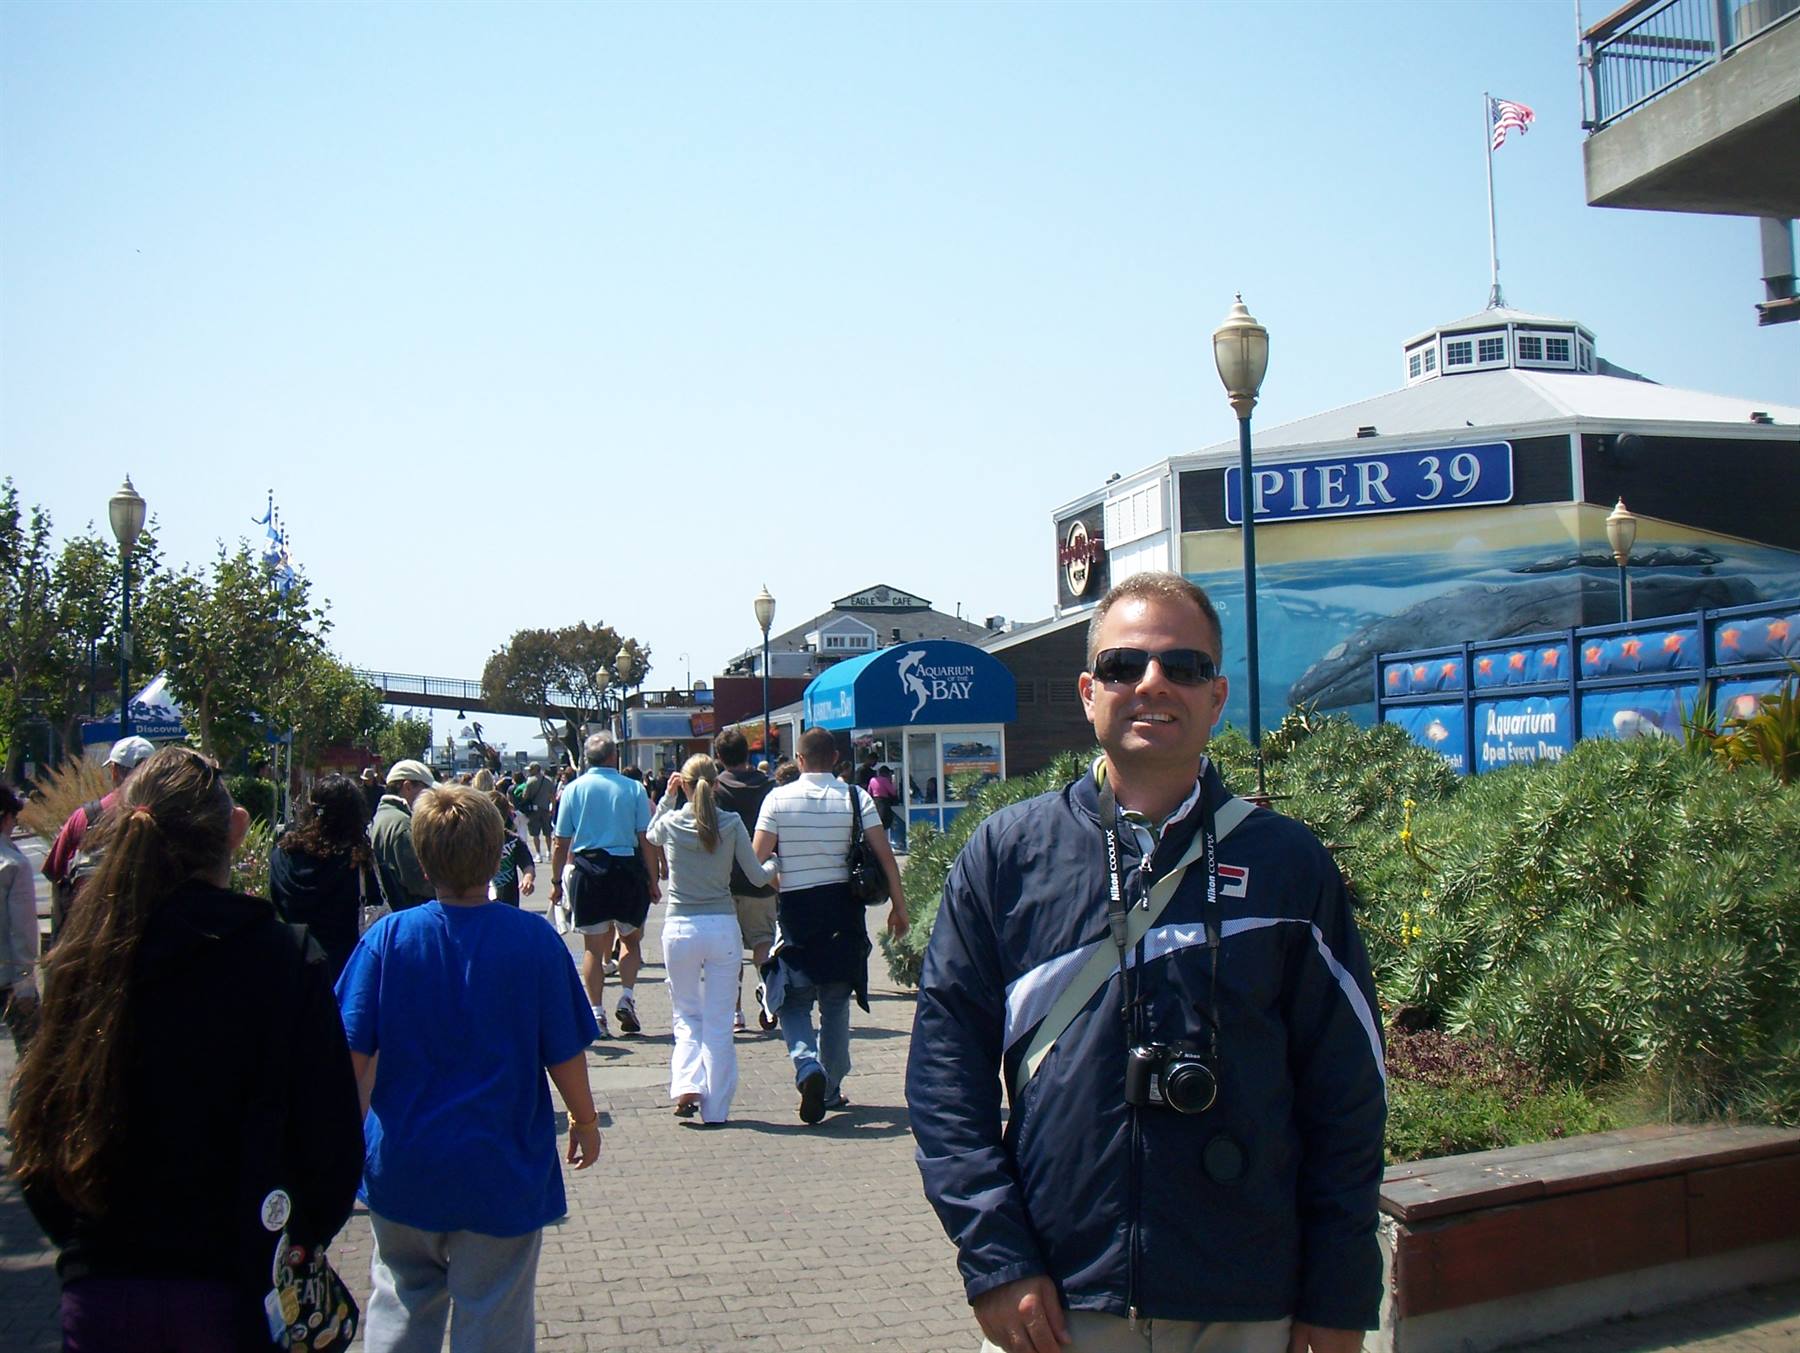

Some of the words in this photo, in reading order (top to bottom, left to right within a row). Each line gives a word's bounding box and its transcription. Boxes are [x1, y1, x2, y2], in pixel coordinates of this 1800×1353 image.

[1253, 461, 1396, 514] PIER
[1416, 453, 1481, 500] 39
[851, 597, 876, 606] EAGLE
[892, 597, 912, 606] CAFE
[915, 664, 974, 680] AQUARIUM
[932, 680, 973, 700] BAY
[135, 725, 183, 734] Discover
[1487, 708, 1556, 741] Aquarium
[1483, 742, 1506, 765] Open
[1508, 741, 1535, 762] Every
[1106, 829, 1118, 872] COOLPIX
[1110, 872, 1120, 902] Nikon
[1207, 875, 1217, 904] Nikon
